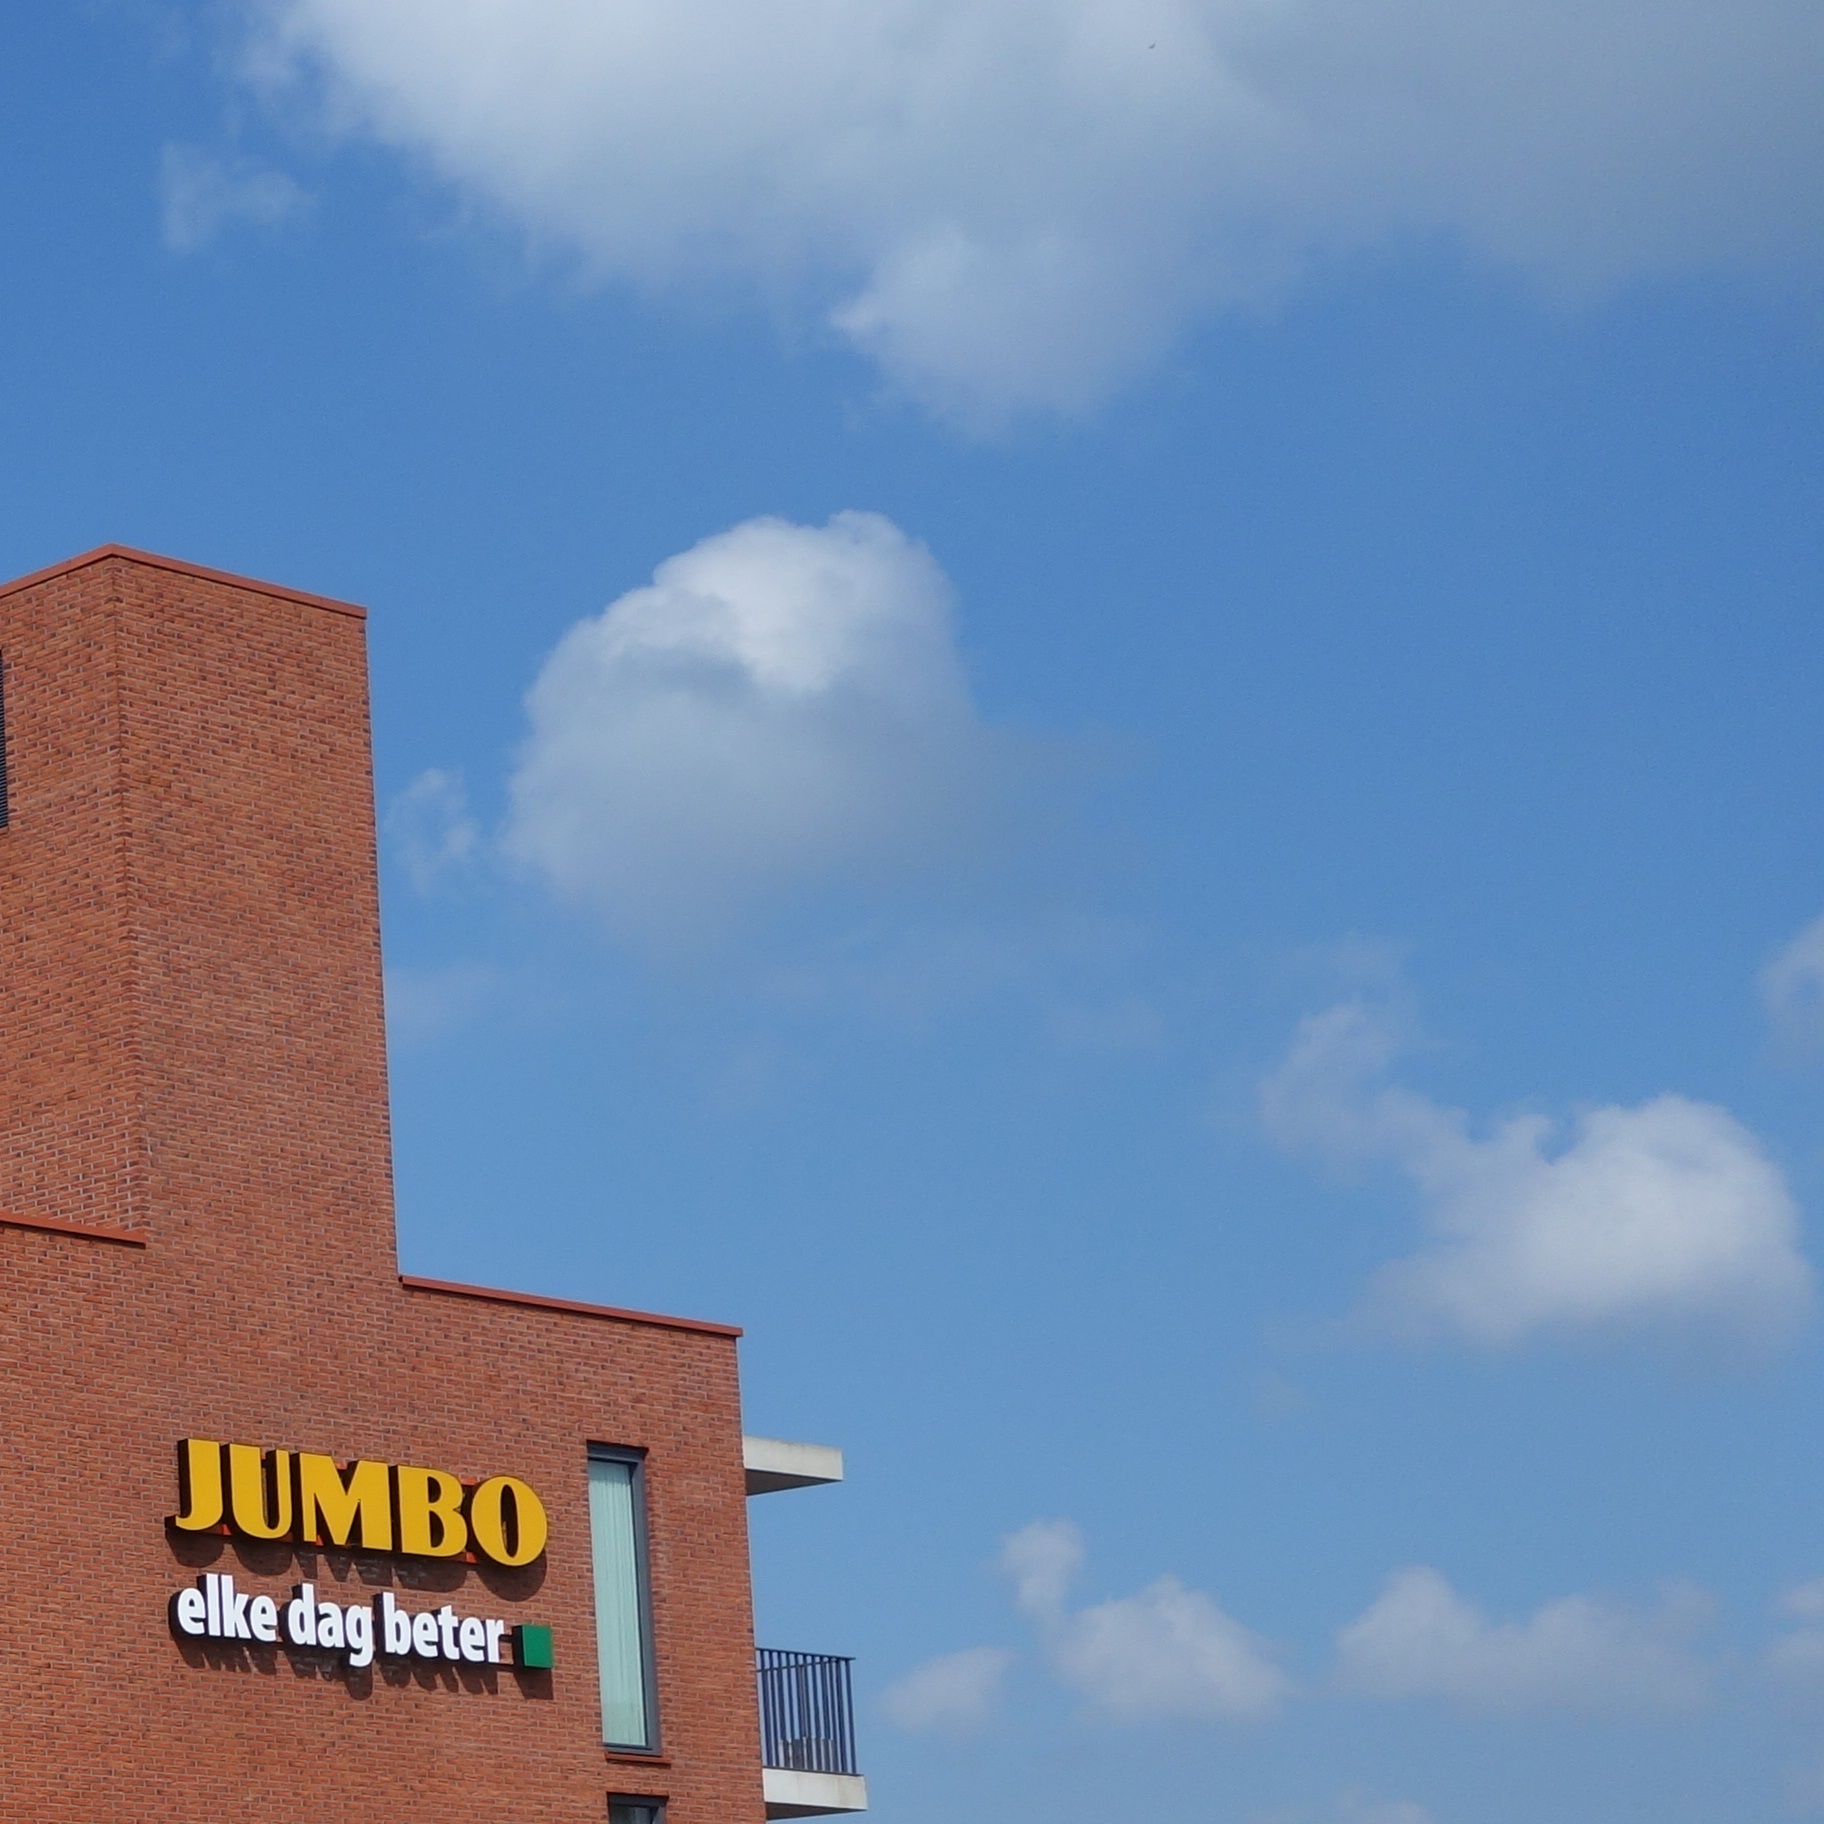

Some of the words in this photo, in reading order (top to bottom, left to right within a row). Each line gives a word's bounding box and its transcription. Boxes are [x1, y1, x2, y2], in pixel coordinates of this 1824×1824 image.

[172, 1438, 548, 1568] JUMBO
[175, 1572, 278, 1642] elke
[287, 1582, 373, 1668] dag
[381, 1590, 505, 1665] beter
